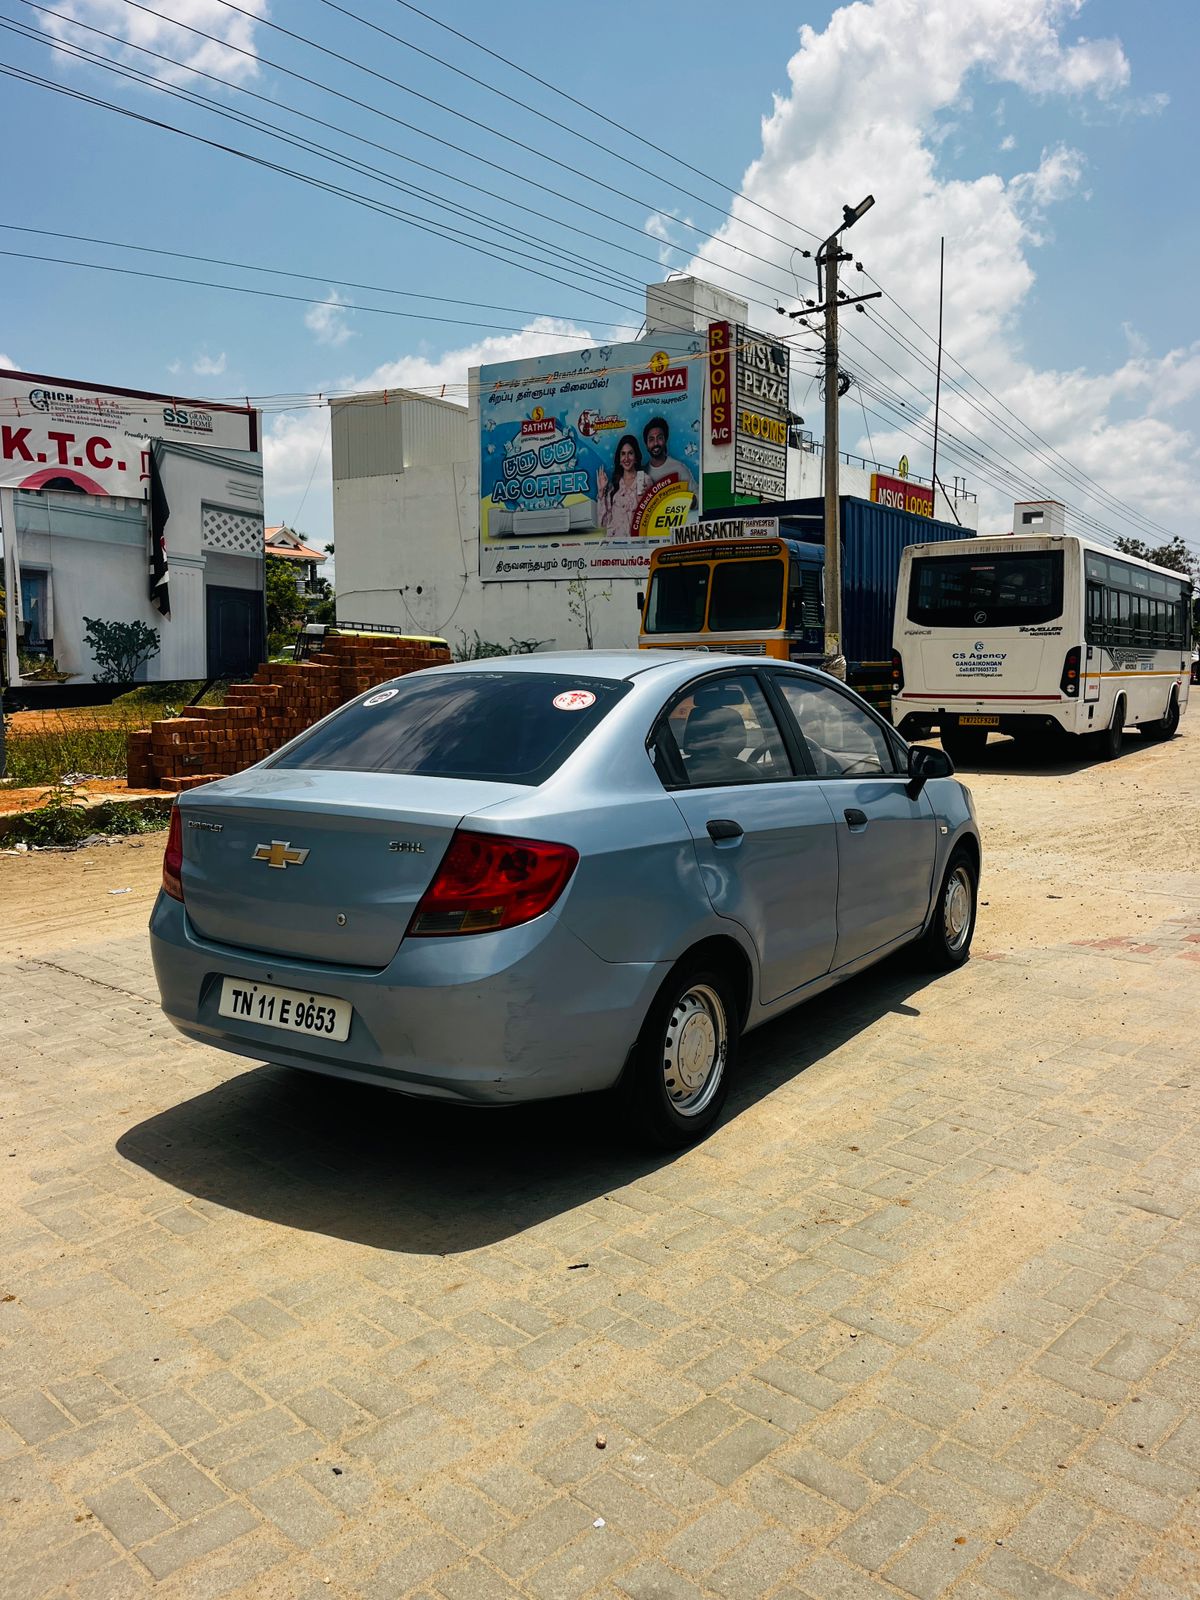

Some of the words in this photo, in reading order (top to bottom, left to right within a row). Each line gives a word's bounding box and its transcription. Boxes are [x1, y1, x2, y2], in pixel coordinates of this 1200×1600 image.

[634, 373, 684, 392] SATHYA
[711, 329, 726, 423] ROOMS
[44, 390, 74, 403] RICH
[488, 391, 513, 406] சிறப்பு
[516, 387, 556, 402] தள்ளுபடி
[560, 378, 609, 394] விலையில்!
[744, 370, 785, 404] PLAZA
[631, 397, 660, 409] SPREADING
[661, 393, 688, 405] HAPPINESS
[163, 408, 189, 425] SS
[189, 411, 213, 422] GRAND
[190, 420, 213, 429] HOME
[522, 421, 554, 433] SATHYA
[711, 427, 729, 440] A/C
[742, 410, 786, 445] ROOMS
[2, 425, 126, 471] K.T.C.
[503, 449, 538, 479] குளு
[539, 437, 576, 469] குளு
[492, 479, 520, 502] AC
[521, 471, 590, 498] OFFER
[632, 511, 643, 530] Cash
[639, 493, 653, 510] Back
[652, 478, 672, 494] Offers
[642, 513, 650, 528] Zero
[659, 485, 682, 499] Payment
[665, 505, 687, 515] EASY
[879, 487, 904, 510] MSVG
[905, 495, 933, 518] LODGE
[654, 515, 684, 528] EMI
[674, 520, 744, 545] MAHASAKTHI
[496, 558, 558, 573] திருவனந்தபுரம்
[561, 557, 588, 571] ரோடு,
[969, 652, 1007, 661] Agency
[388, 841, 426, 854] SAIL
[232, 989, 254, 1016] TN
[258, 994, 276, 1021] 11
[279, 999, 292, 1024] E
[294, 1002, 337, 1034] 9653
